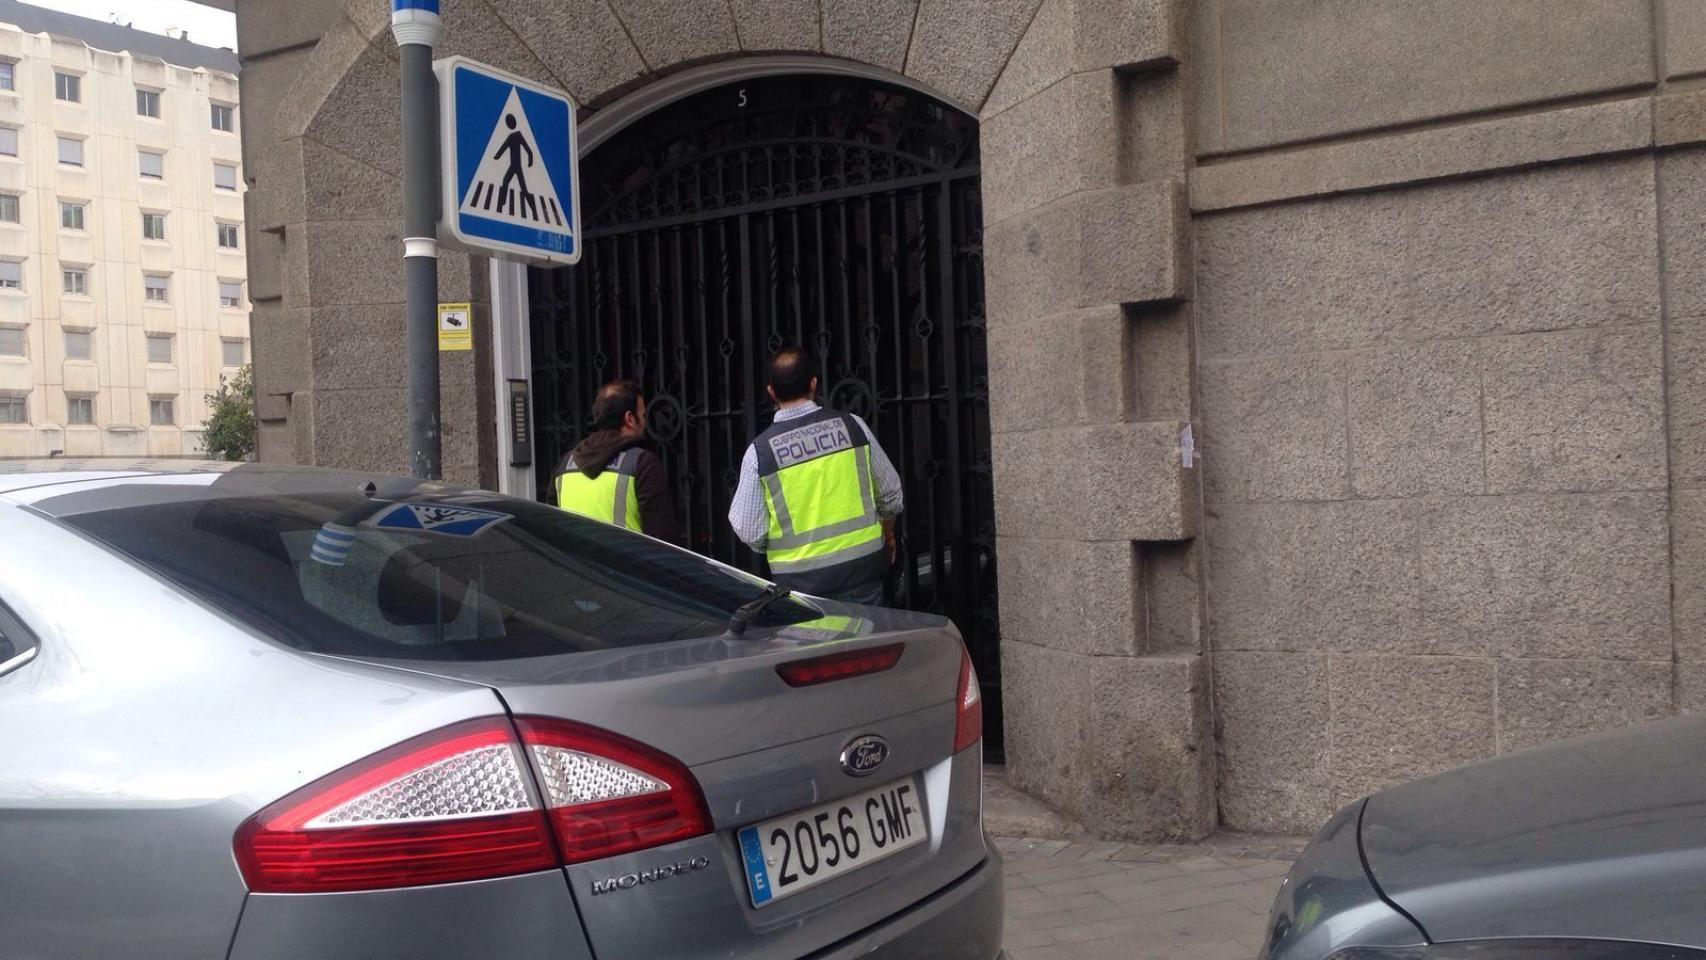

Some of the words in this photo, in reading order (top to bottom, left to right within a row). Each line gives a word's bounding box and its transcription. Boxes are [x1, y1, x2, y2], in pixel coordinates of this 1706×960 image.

[738, 88, 747, 107] 5
[772, 430, 801, 446] CUERPO
[801, 422, 834, 436] NACIONAL
[776, 430, 849, 465] POLICIA
[856, 743, 882, 768] Ford
[770, 806, 861, 887] 2056
[865, 785, 912, 848] GMF
[591, 857, 710, 896] MONDEO
[754, 872, 765, 891] E
